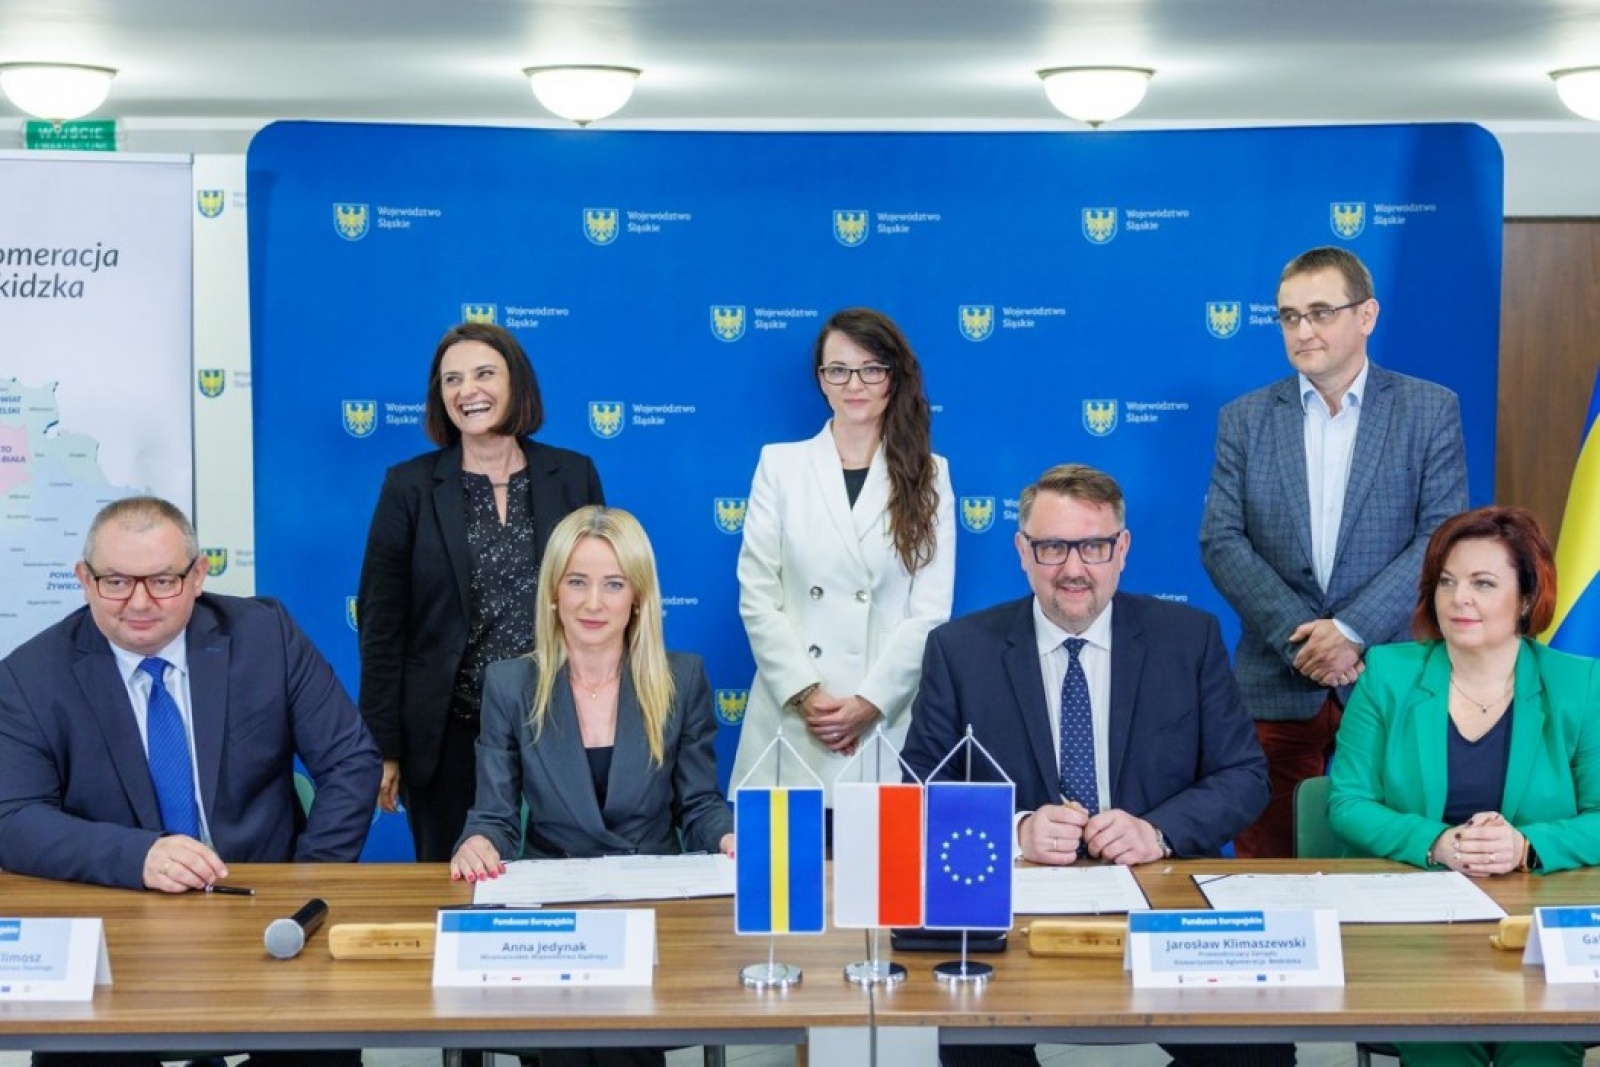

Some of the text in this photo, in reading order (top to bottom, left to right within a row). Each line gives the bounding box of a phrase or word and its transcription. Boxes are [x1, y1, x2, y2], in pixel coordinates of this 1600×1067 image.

[0, 395, 21, 403] WIAT
[502, 942, 587, 954] Anna Jedynak
[1166, 937, 1306, 952] Jarosław Klimaszewski
[0, 952, 41, 963] limosz
